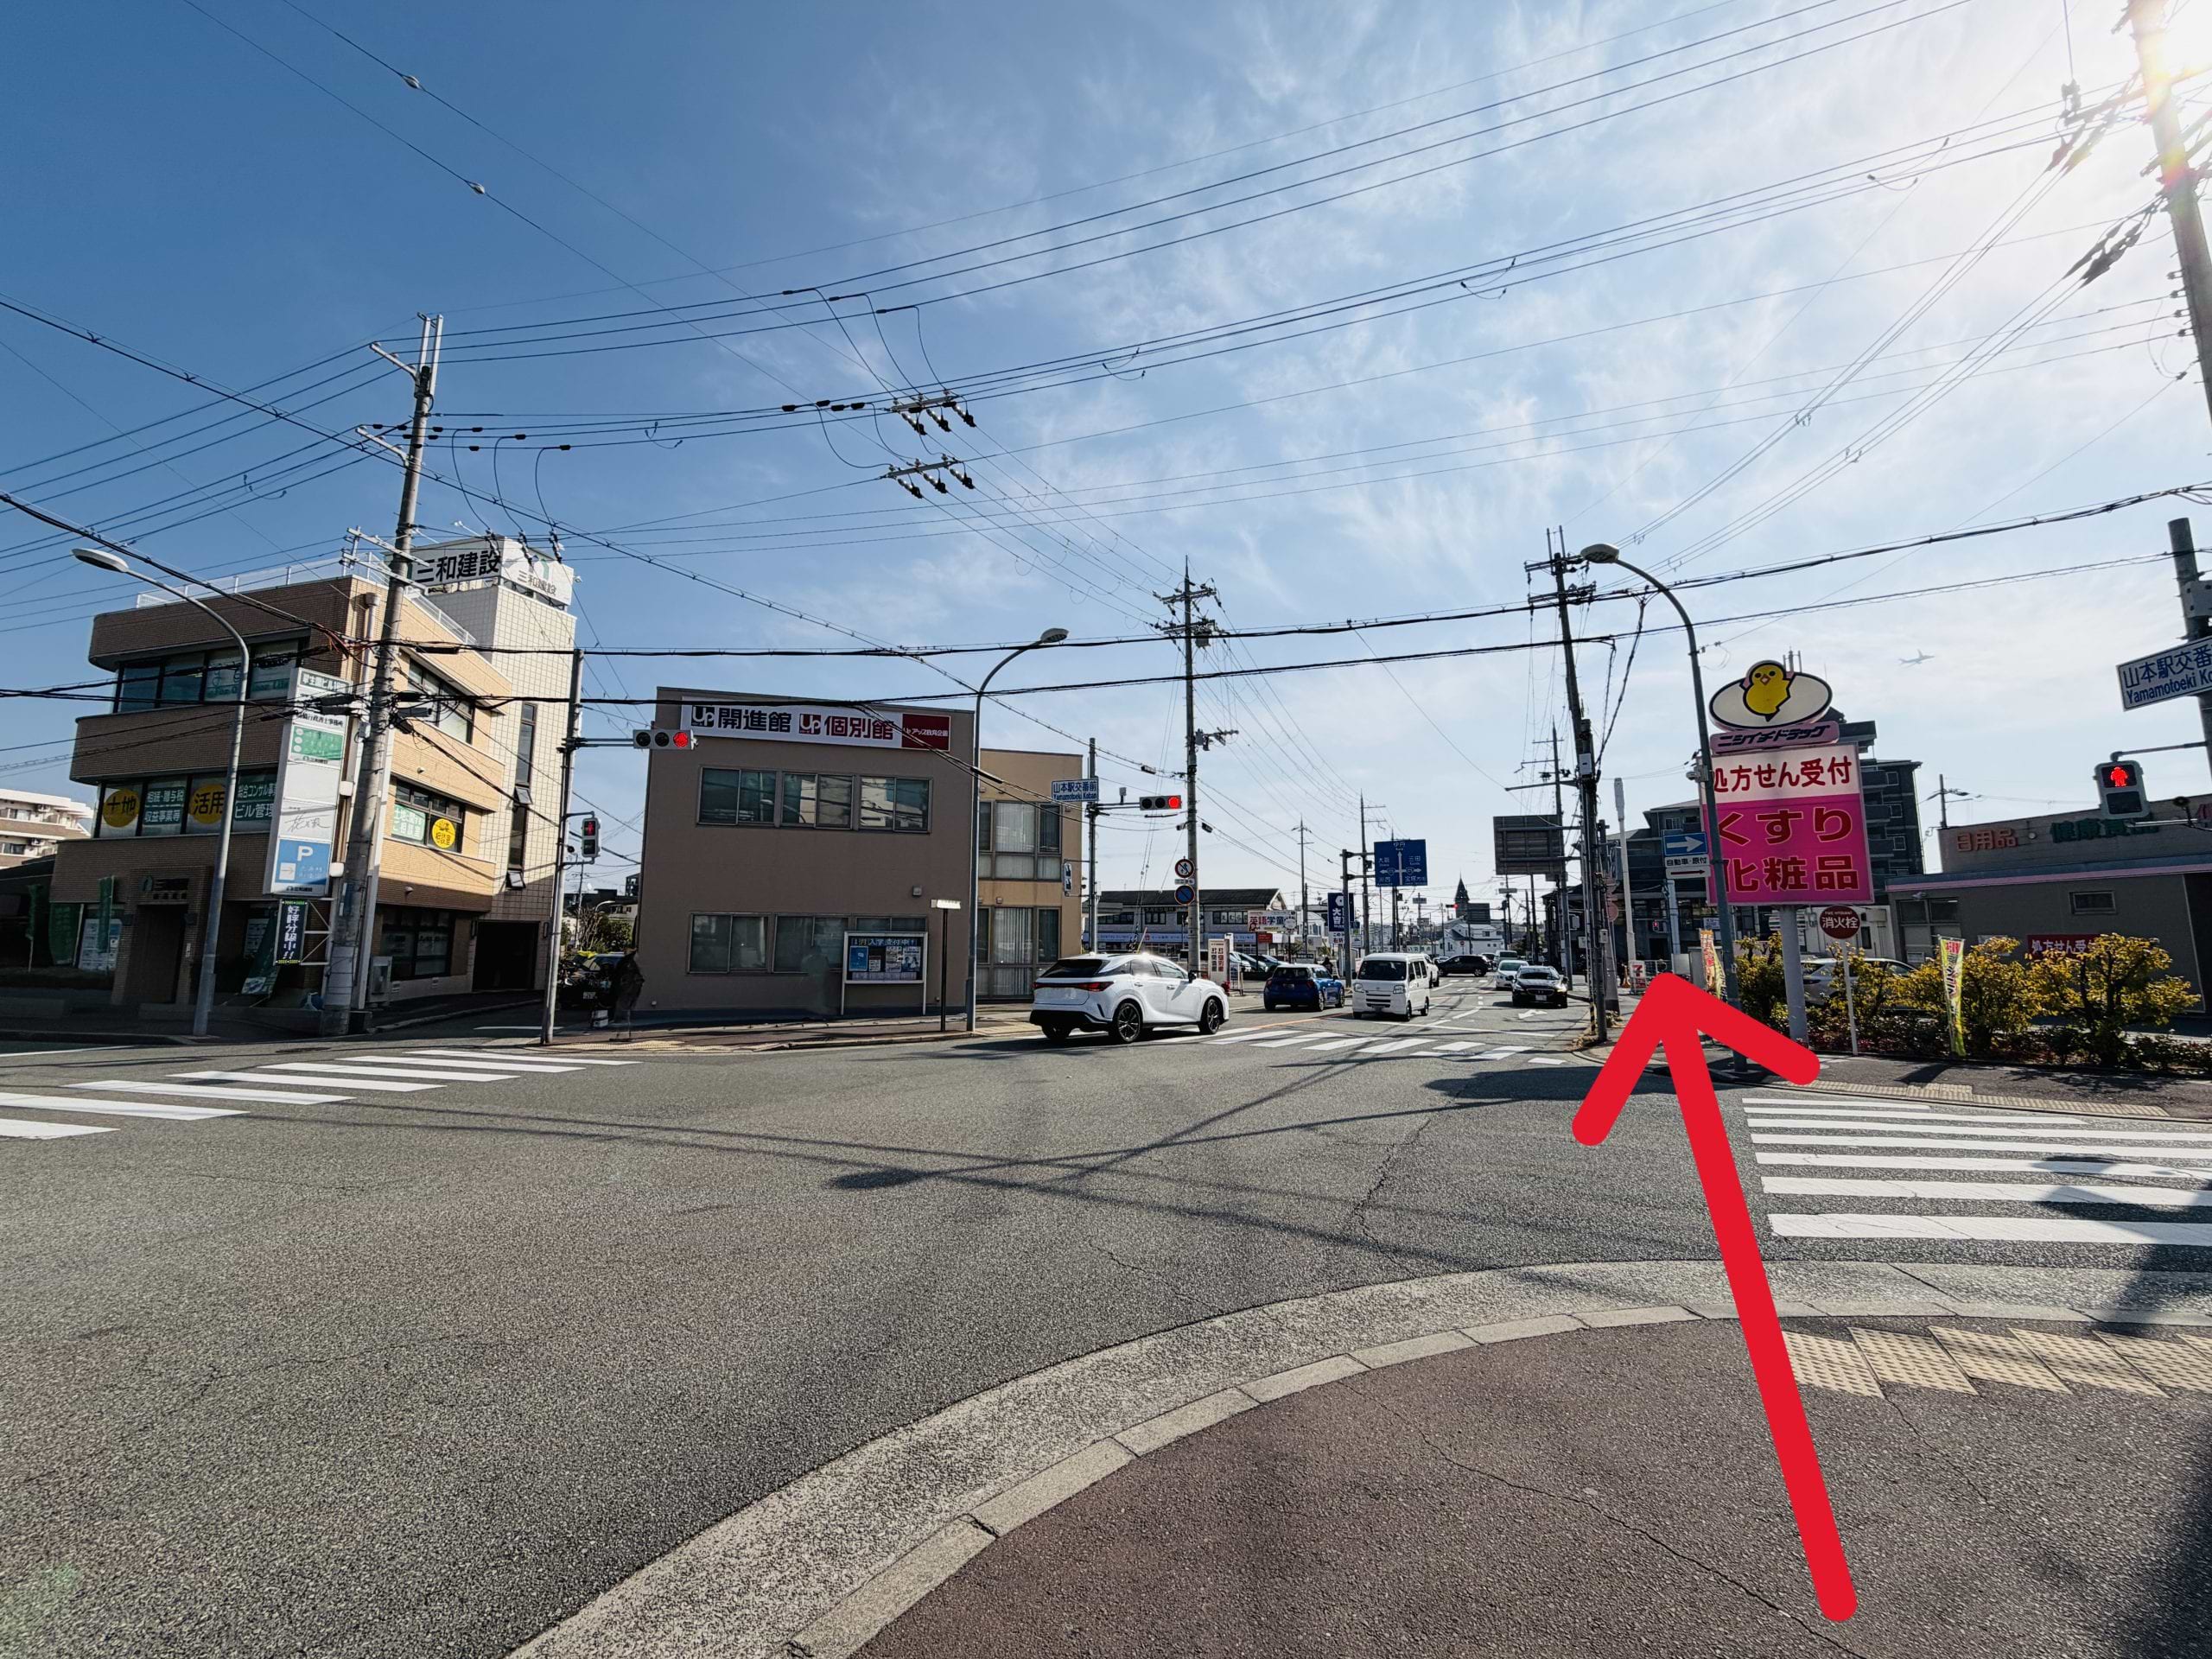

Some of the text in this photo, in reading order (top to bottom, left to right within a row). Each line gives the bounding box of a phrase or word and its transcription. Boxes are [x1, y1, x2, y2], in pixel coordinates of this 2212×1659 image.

[415, 550, 501, 582] 三和建設
[2123, 644, 2212, 688] 山本駅交番
[2126, 672, 2196, 703] Yamamotoeki
[718, 708, 791, 733] 開進館
[824, 715, 893, 741] 個別館
[1718, 725, 1830, 747] ニシイチドラッグ
[237, 782, 276, 800] 総合コンサル事
[1053, 781, 1096, 793] 山本駅交番前
[107, 794, 136, 817] 土地
[194, 791, 225, 815] 活用
[1719, 807, 1852, 846] くすり
[1957, 830, 2018, 852] 日用品
[297, 846, 314, 861] P
[1724, 855, 1859, 892] 化粧品
[1821, 917, 1859, 929] 消火栓
[2031, 940, 2093, 955] 処方せん受
